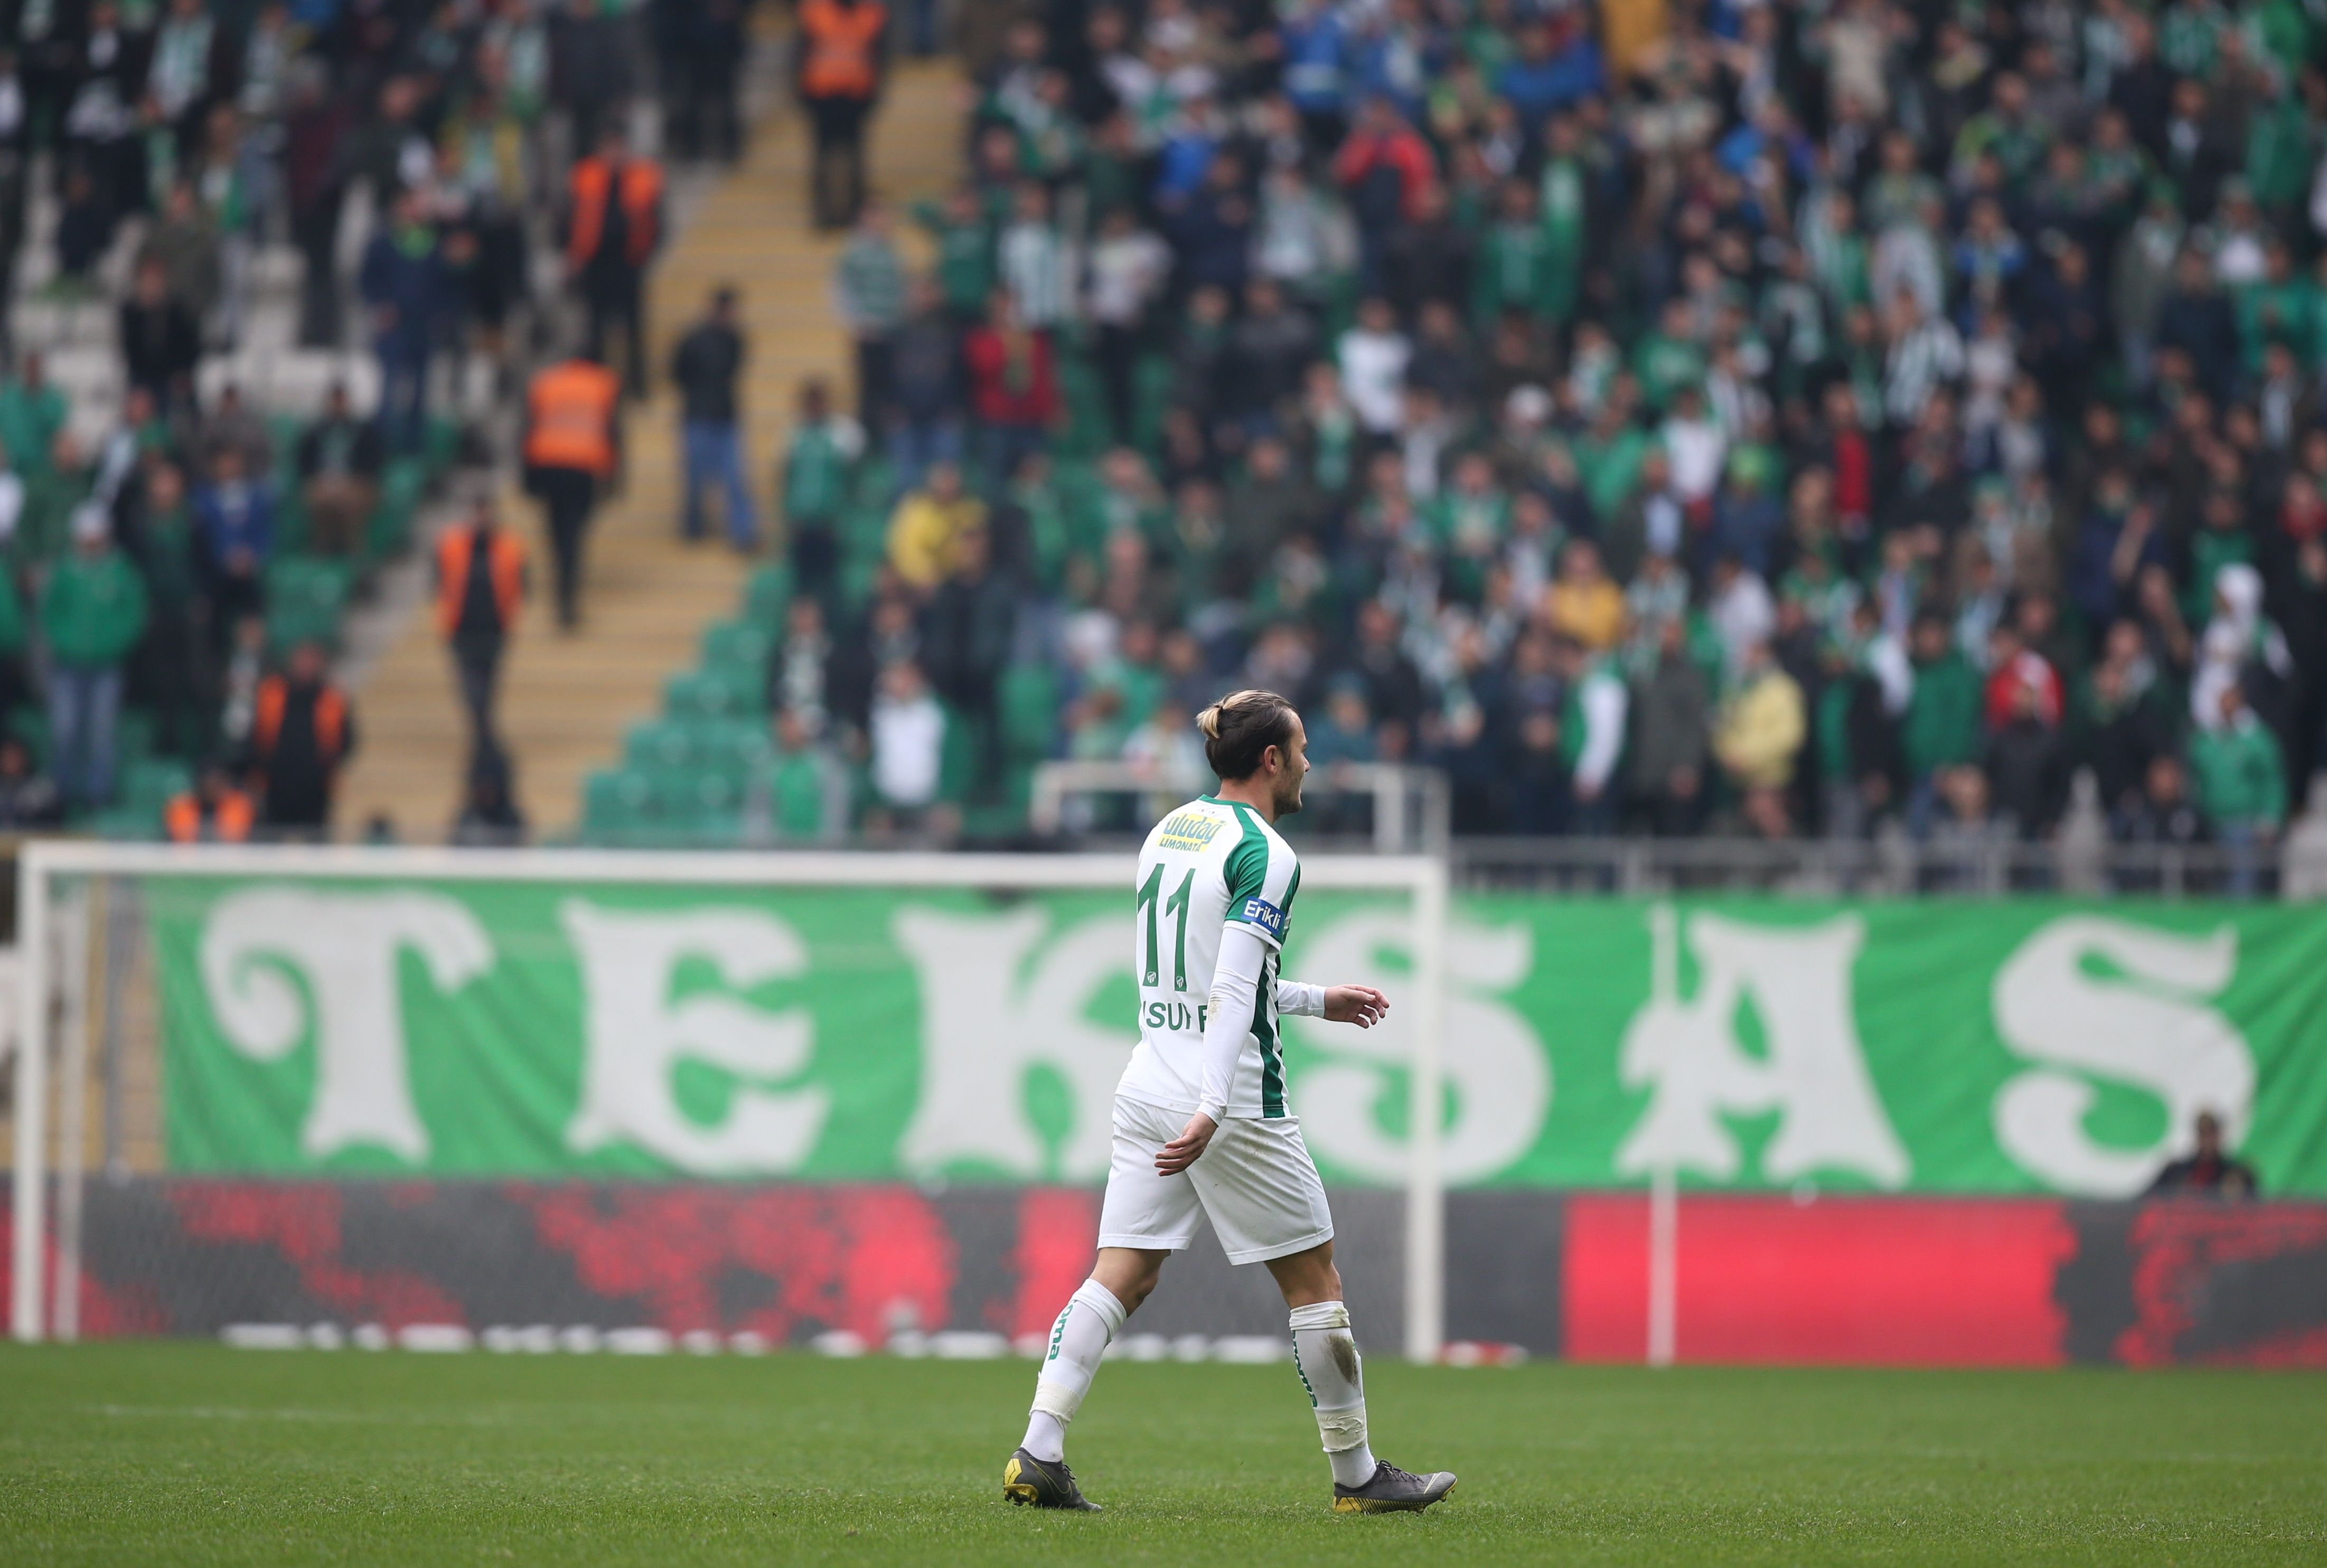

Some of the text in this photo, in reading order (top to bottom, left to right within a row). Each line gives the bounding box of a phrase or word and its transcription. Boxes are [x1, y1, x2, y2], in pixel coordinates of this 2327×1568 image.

[1159, 836, 1202, 852] LİMONATA
[1164, 814, 1227, 844] uludağ
[1137, 863, 1196, 992] 11
[1244, 899, 1281, 929] Erikli
